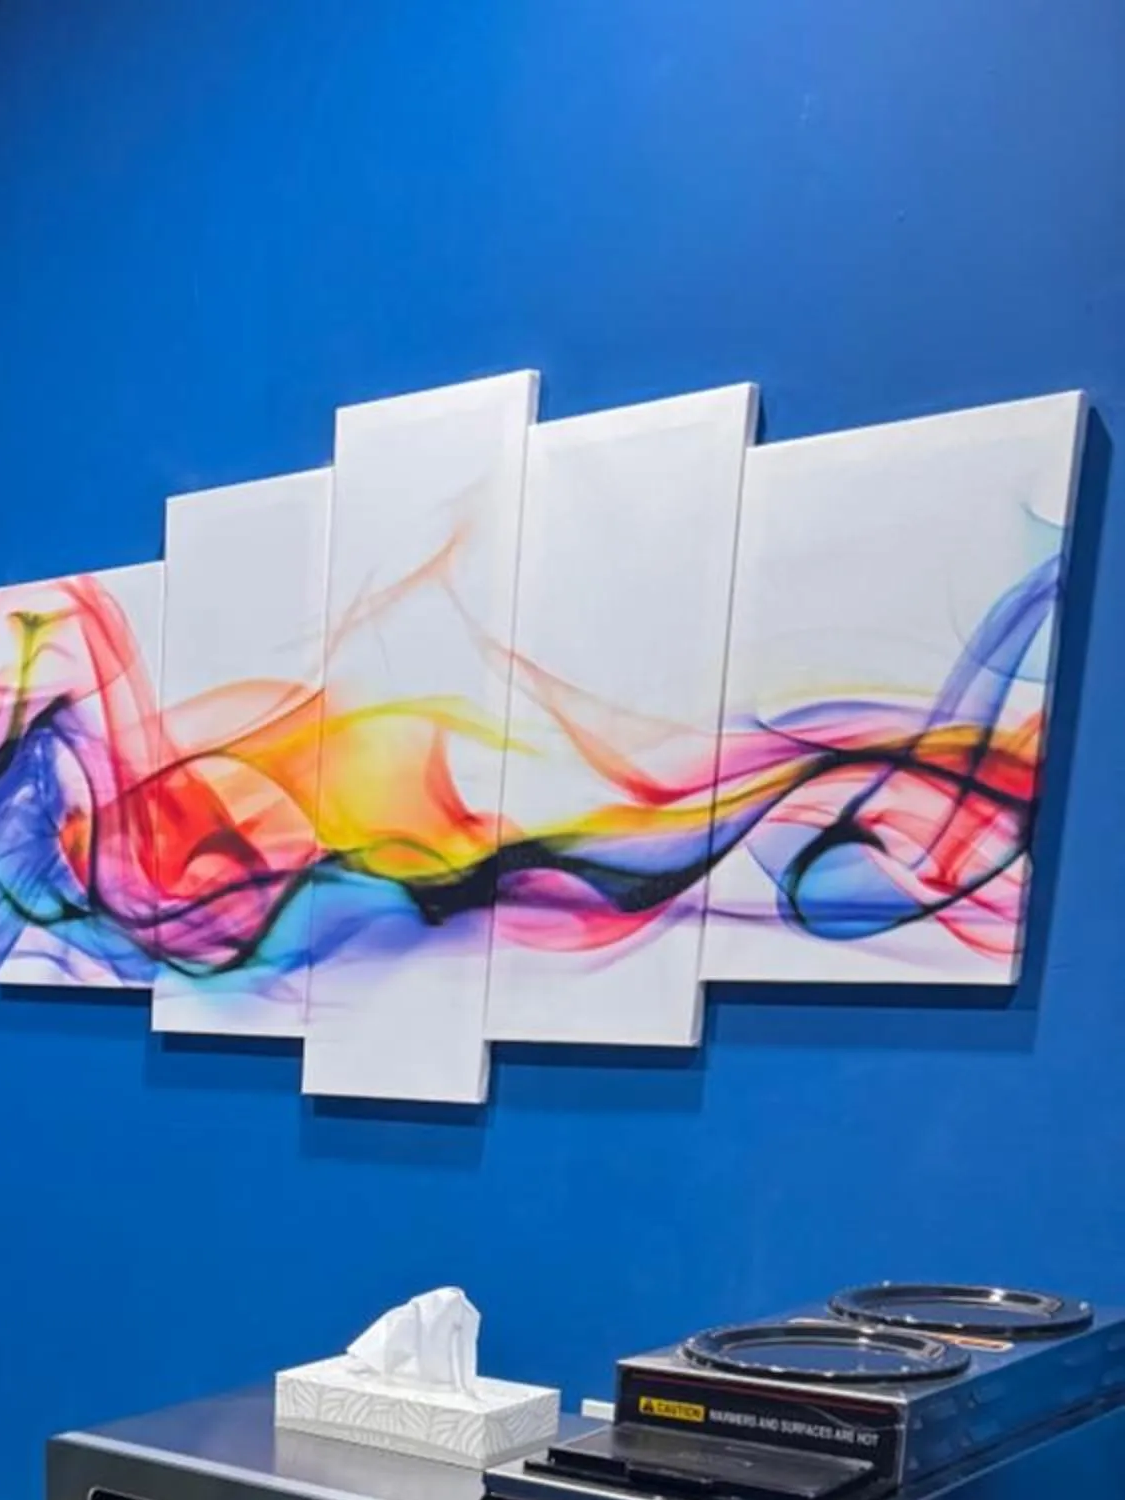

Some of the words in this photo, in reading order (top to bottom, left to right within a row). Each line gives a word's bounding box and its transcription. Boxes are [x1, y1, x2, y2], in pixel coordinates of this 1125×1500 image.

[758, 1416, 778, 1431] AND
[780, 1419, 832, 1440] SURFACES
[856, 1432, 880, 1447] HOT
